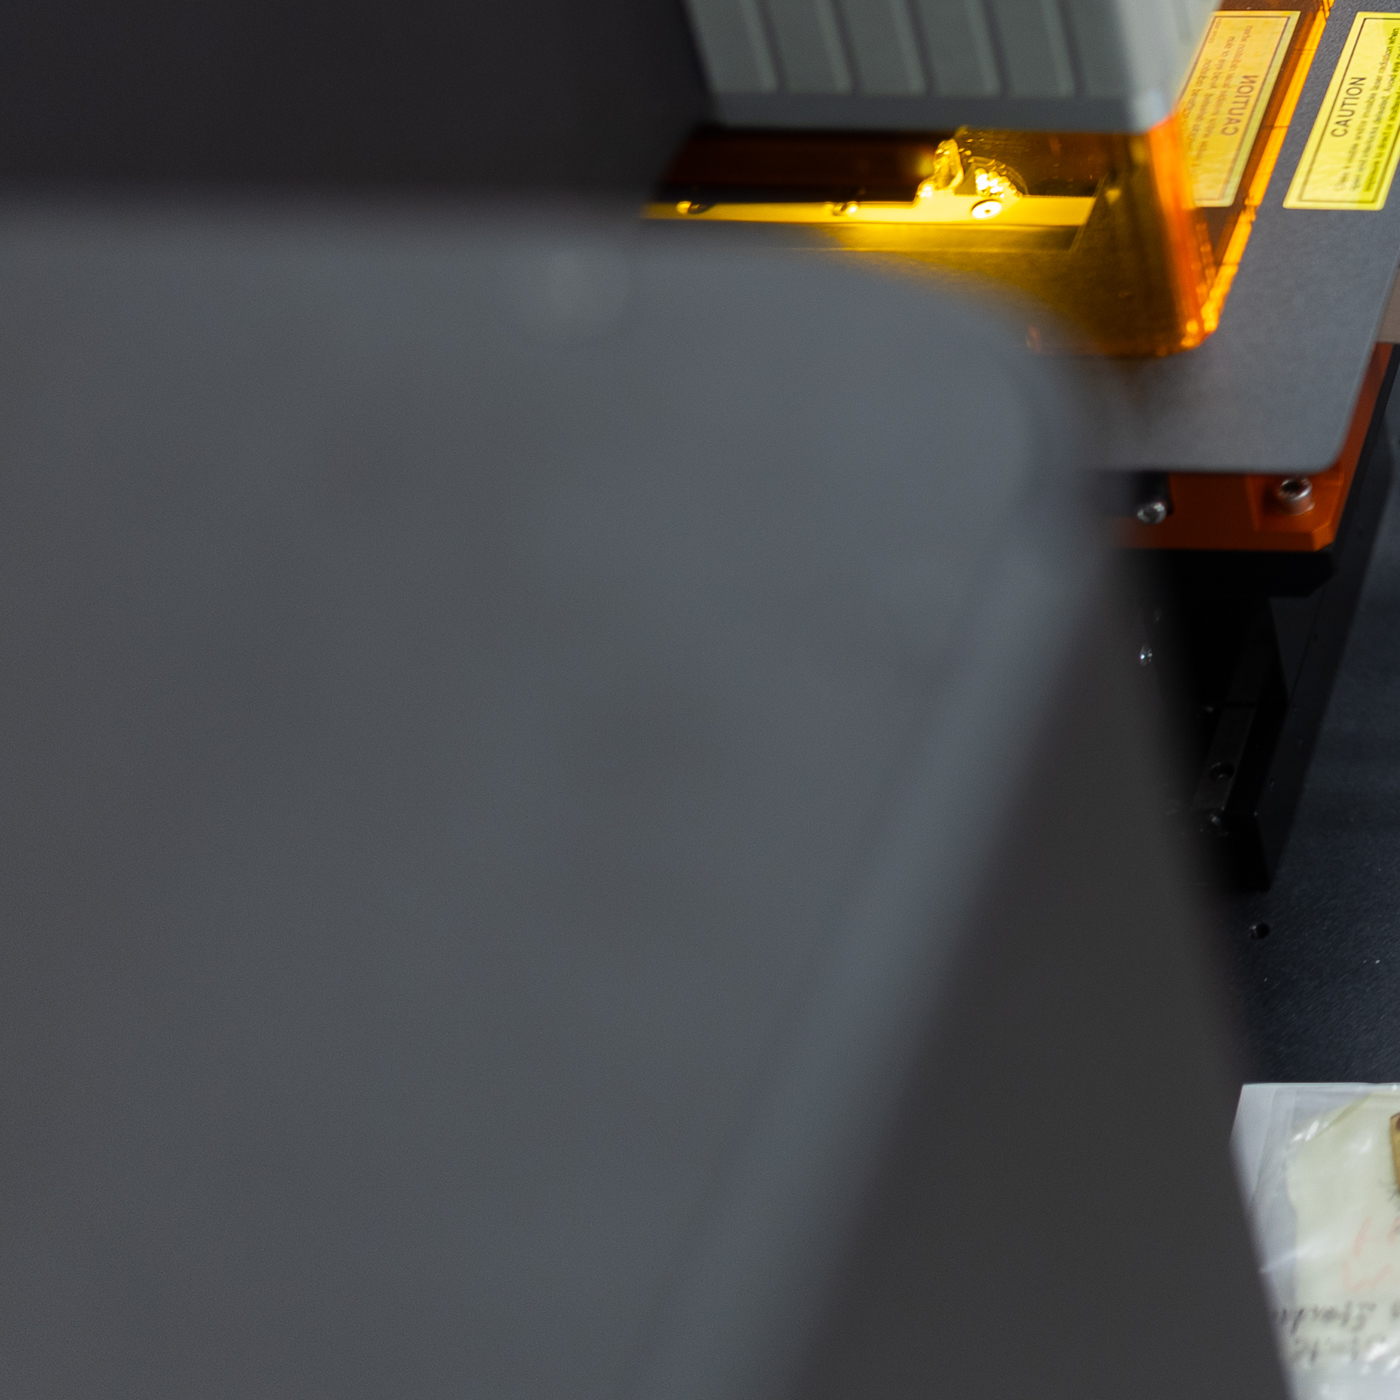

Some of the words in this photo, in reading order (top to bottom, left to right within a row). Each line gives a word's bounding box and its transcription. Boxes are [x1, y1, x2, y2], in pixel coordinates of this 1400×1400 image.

[1377, 46, 1393, 73] radiation
[1387, 28, 1399, 44] when
[1382, 74, 1397, 91] Avoid
[1330, 77, 1366, 137] CAUTION
